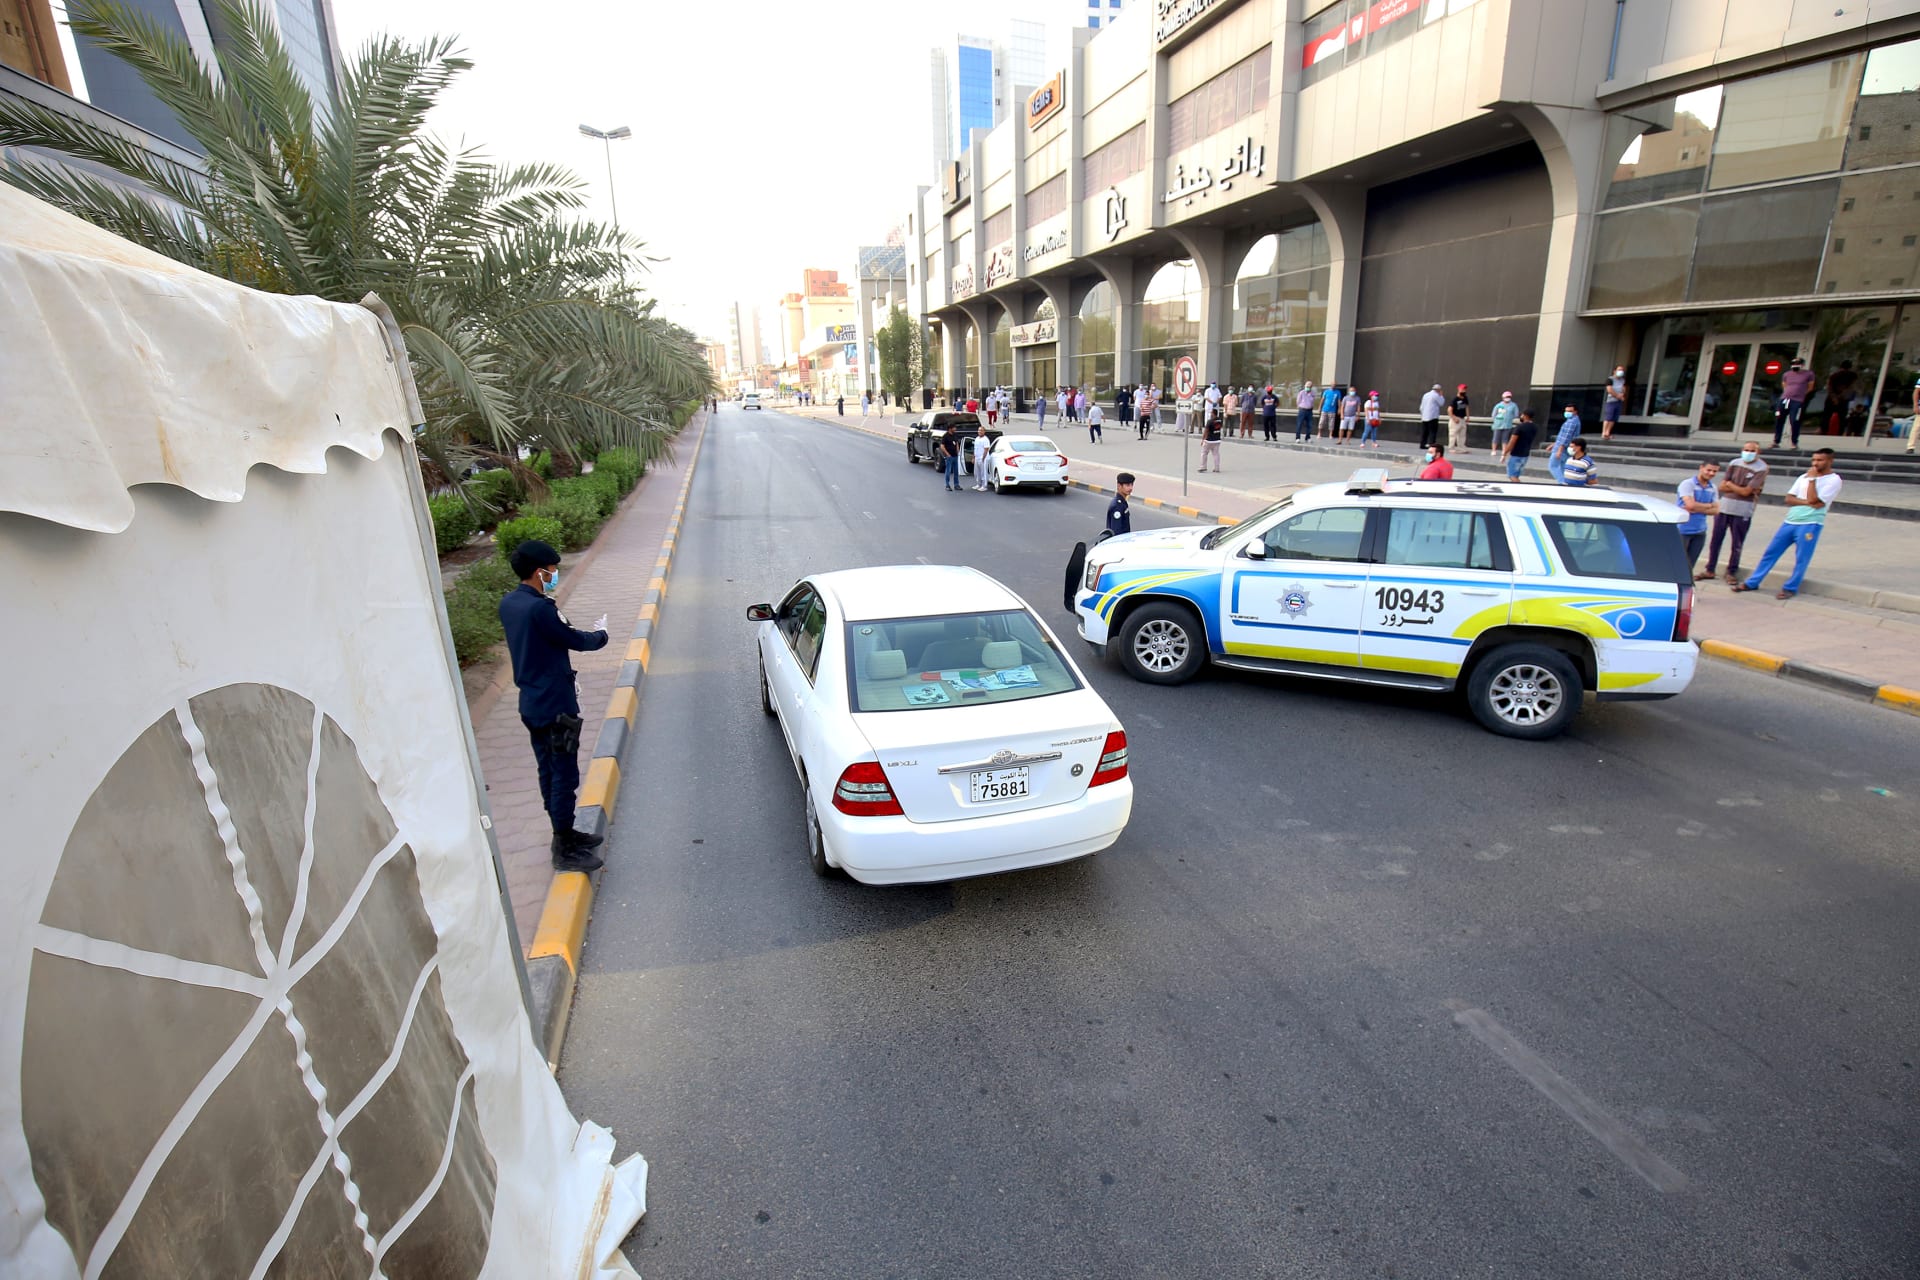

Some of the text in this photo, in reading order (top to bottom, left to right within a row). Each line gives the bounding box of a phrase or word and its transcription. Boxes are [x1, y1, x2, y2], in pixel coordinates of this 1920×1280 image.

[1032, 87, 1053, 117] KEMS
[1181, 367, 1192, 392] P
[1375, 587, 1445, 613] 10943
[1379, 613, 1434, 627] مرور
[986, 772, 993, 783] 5
[980, 780, 1027, 799] 75881
